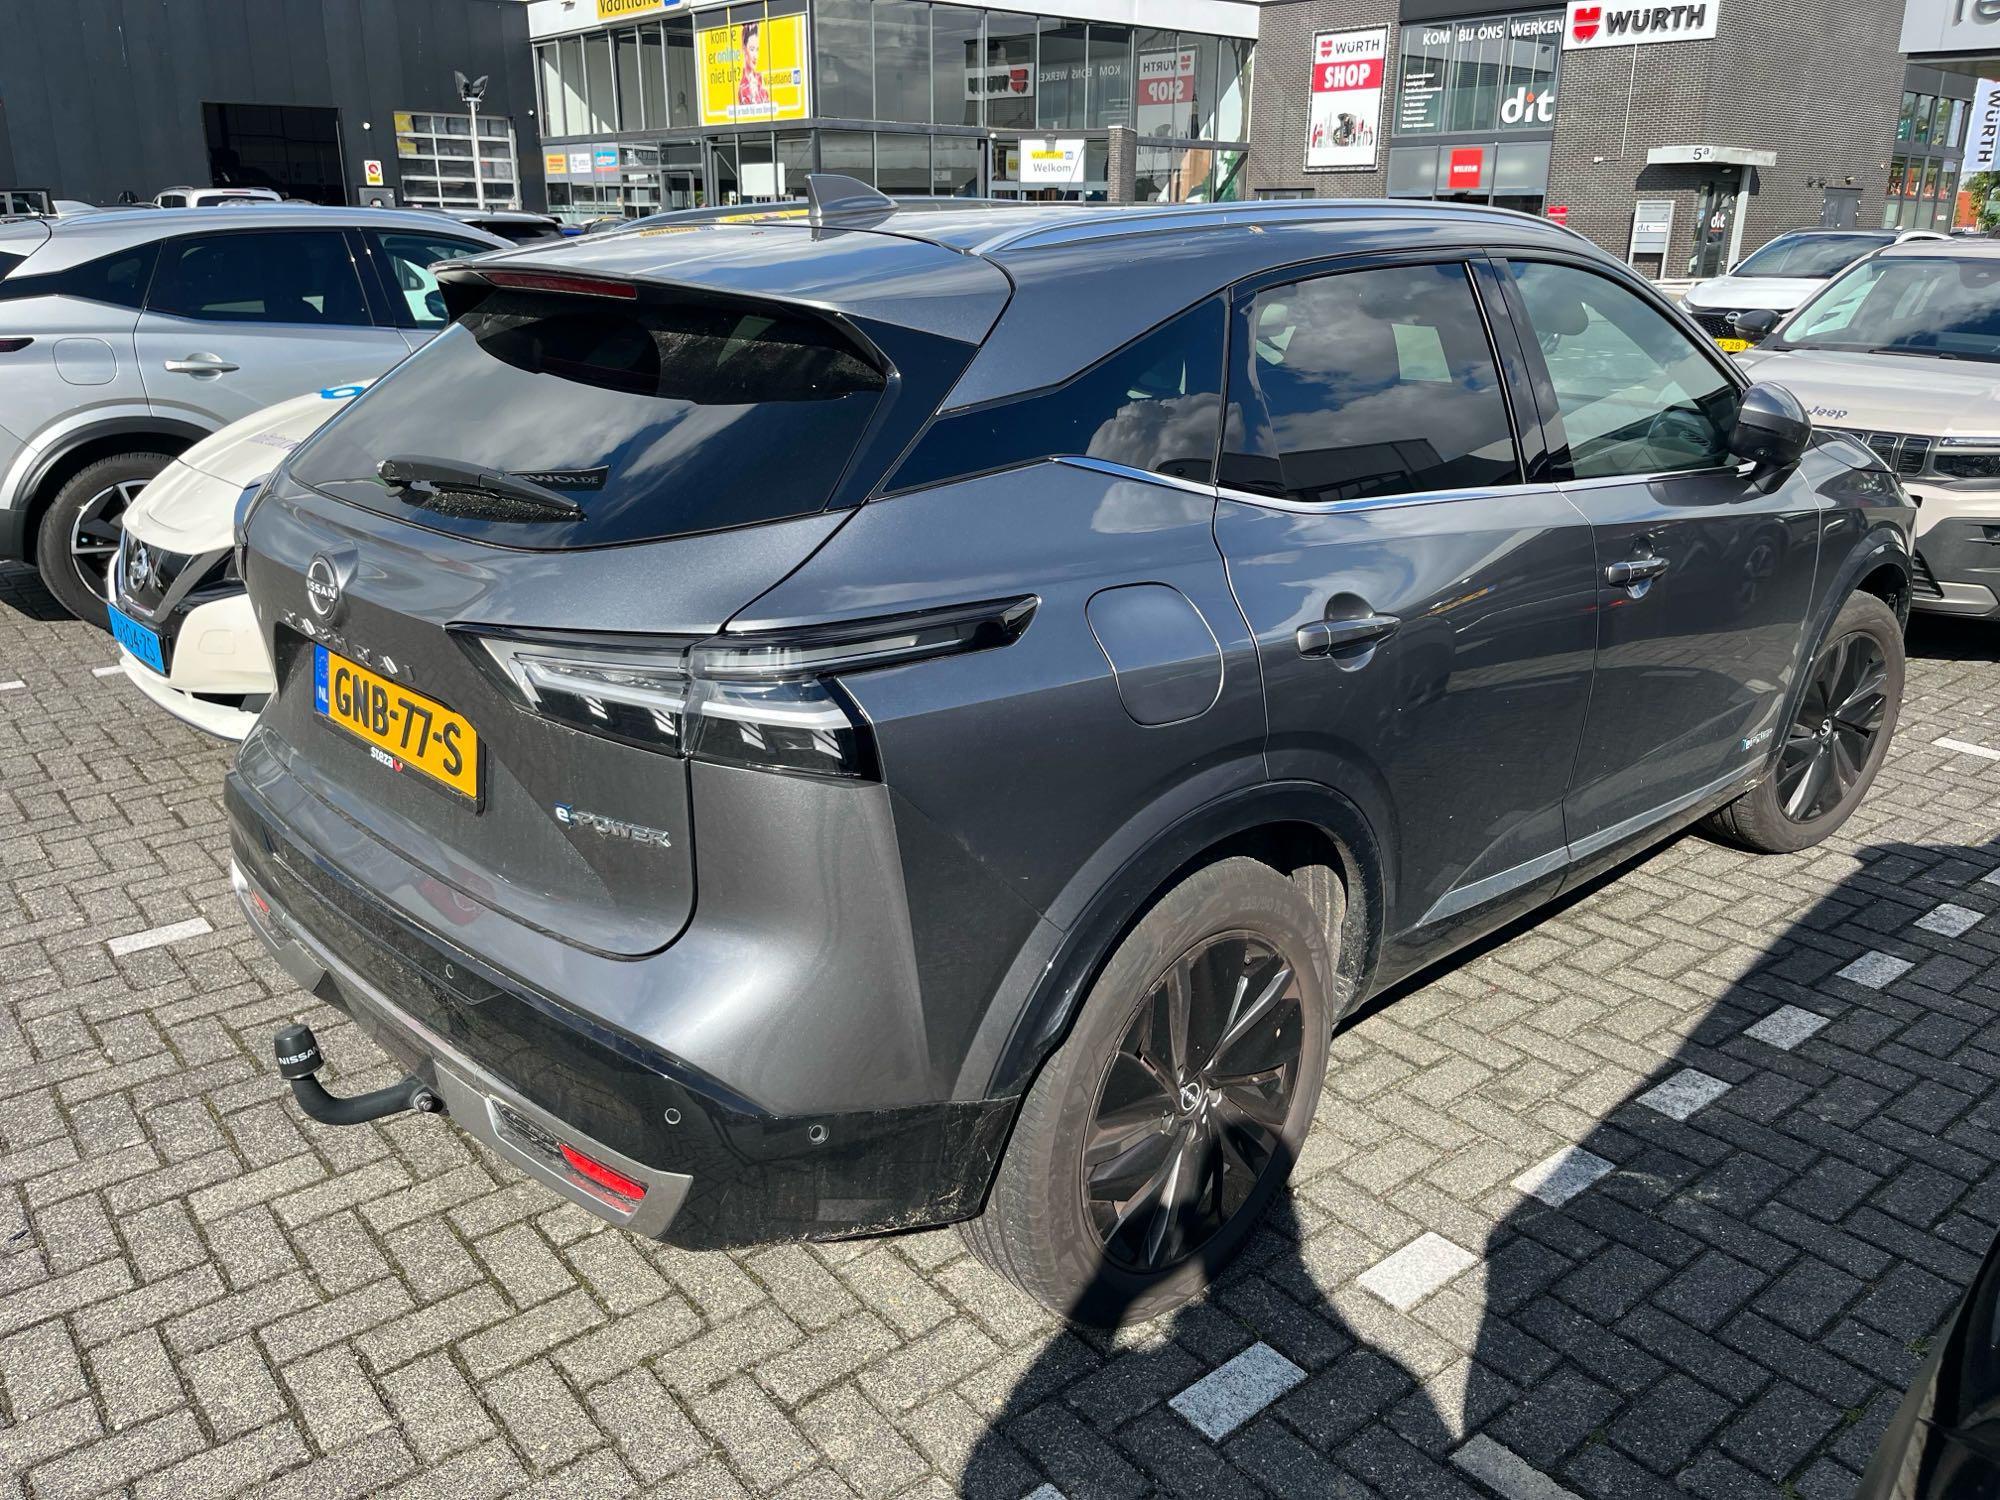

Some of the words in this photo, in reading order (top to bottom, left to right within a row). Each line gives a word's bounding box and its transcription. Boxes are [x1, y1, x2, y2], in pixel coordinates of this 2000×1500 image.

[1606, 4, 1706, 34] WÜRTH
[711, 30, 727, 44] kom
[1422, 30, 1451, 45] KOM
[1478, 25, 1503, 40] ONS
[1511, 20, 1563, 37] WERKEN
[1336, 39, 1380, 54] WÜRTH
[710, 68, 726, 84] niet
[727, 67, 741, 83] ut?
[1324, 63, 1371, 89] SHOP
[1501, 86, 1555, 124] dit
[1033, 163, 1071, 173] Welkom
[1711, 212, 1726, 228] dit
[1807, 406, 1848, 419] Jeep
[308, 580, 336, 599] SSAN
[318, 686, 329, 704] NL
[335, 667, 463, 777] GNB-77-S
